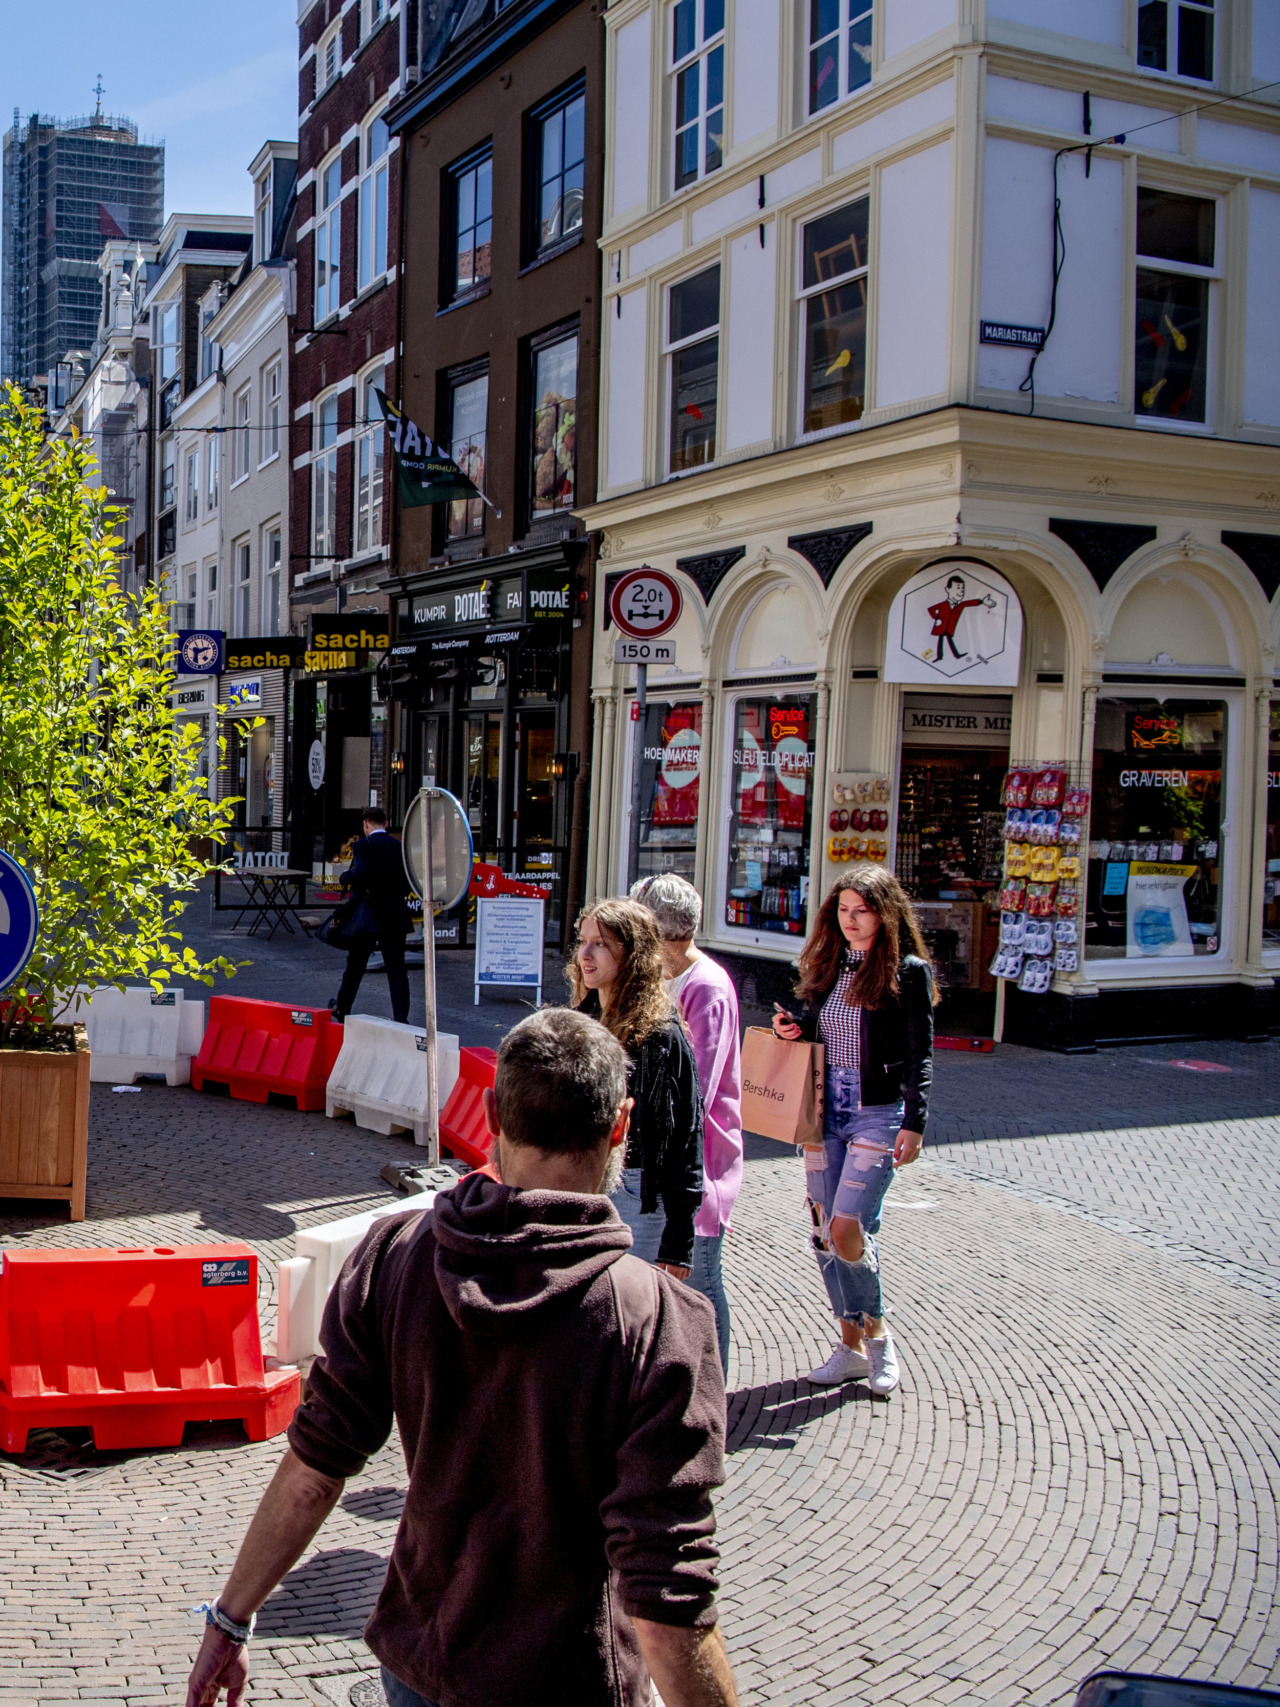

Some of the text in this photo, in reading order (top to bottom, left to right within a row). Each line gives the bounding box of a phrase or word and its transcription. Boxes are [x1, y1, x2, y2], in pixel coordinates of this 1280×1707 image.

[985, 326, 1042, 344] MARIASTRAAT
[414, 605, 446, 624] KUMPIR
[315, 630, 390, 648] sacha
[485, 631, 520, 644] ROTTERDAM
[391, 646, 417, 655] AMSTERDAM
[431, 640, 470, 650] The Kumpir Company
[622, 645, 670, 658] 150 m
[228, 651, 291, 668] sacha
[770, 707, 804, 722] Service
[912, 714, 978, 729] MISTER
[1134, 716, 1177, 730] Service
[1120, 770, 1189, 787] GRAVEREN
[514, 872, 560, 880] AARDAPPEL
[1136, 865, 1186, 876] MONDKAPJES
[742, 1079, 785, 1102] Bershka
[202, 1270, 236, 1279] agterberg
